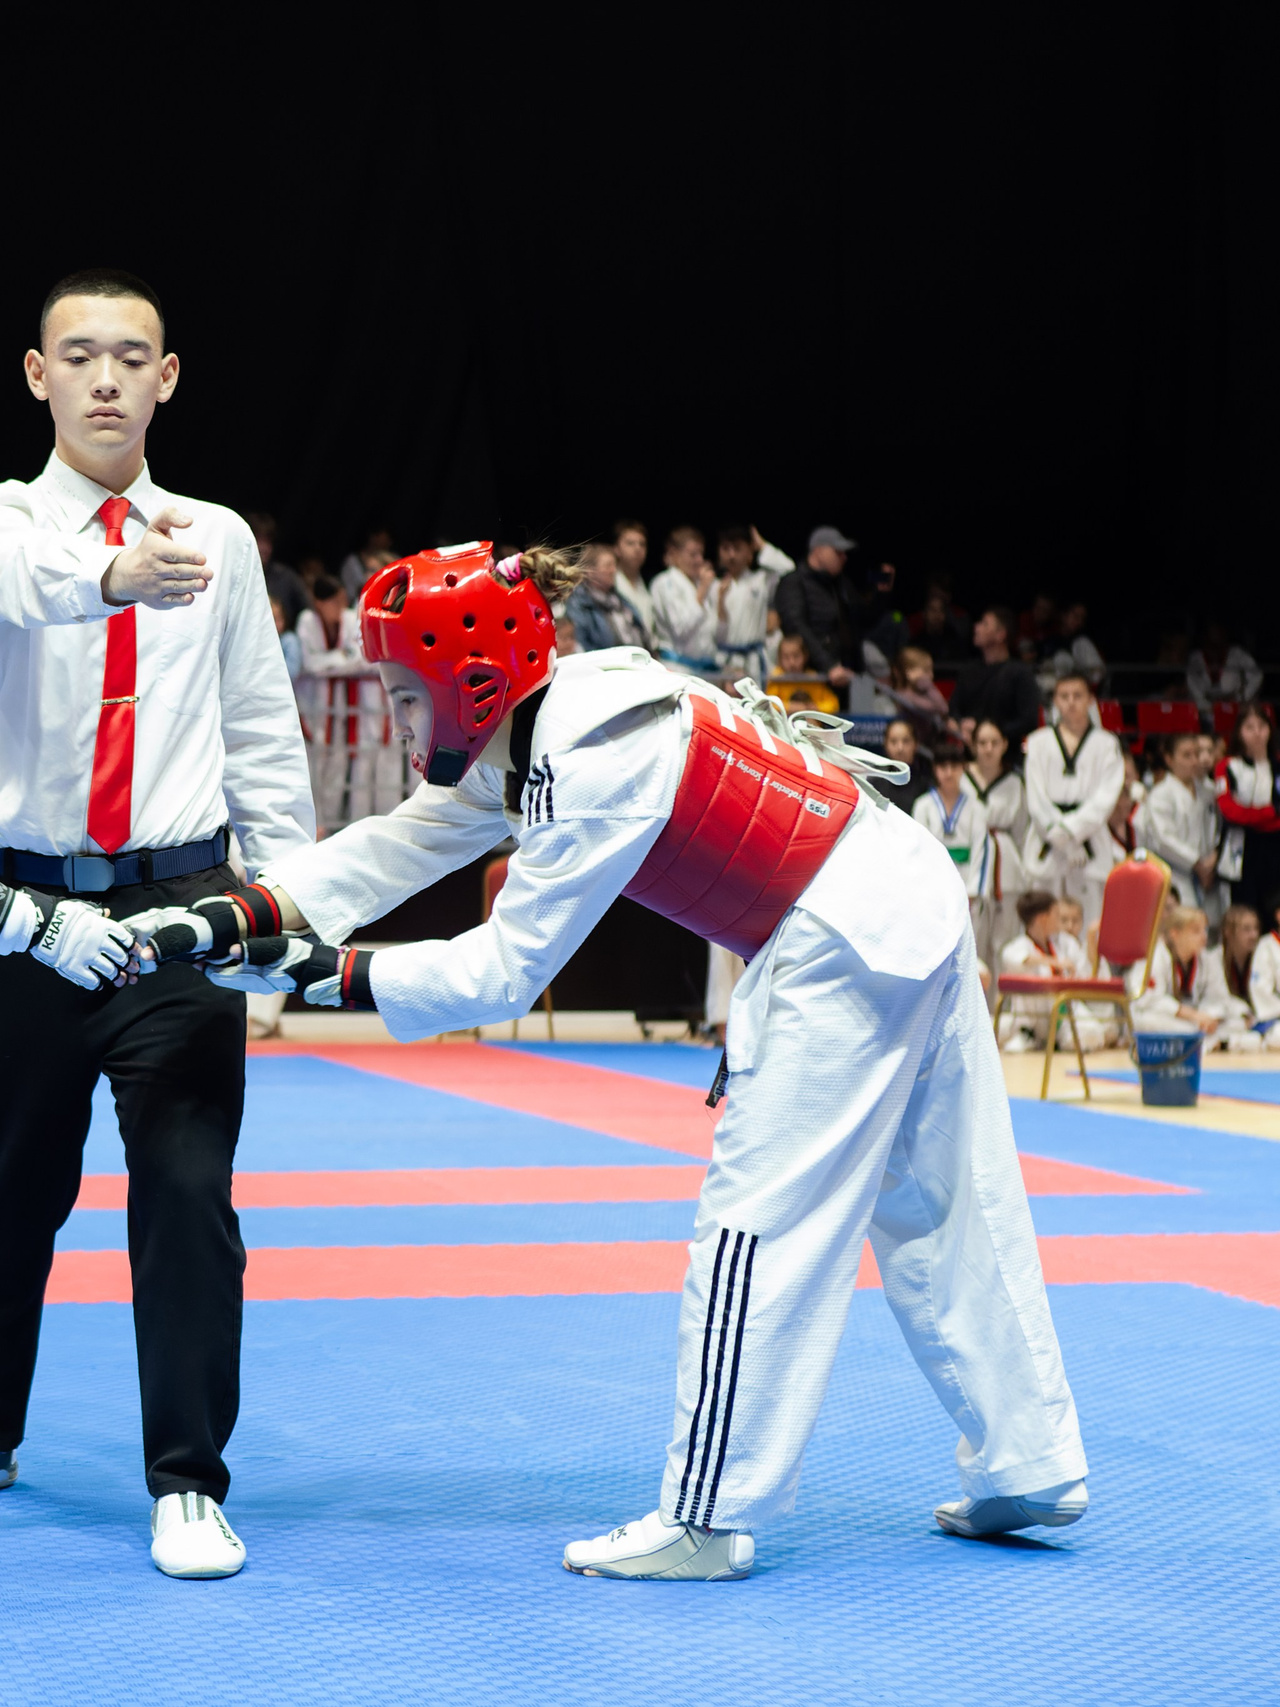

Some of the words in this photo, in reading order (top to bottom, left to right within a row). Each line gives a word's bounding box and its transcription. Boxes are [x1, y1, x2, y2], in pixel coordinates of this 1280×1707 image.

[736, 759, 763, 781] Scoring
[809, 803, 827, 815] PSS
[41, 909, 67, 951] KHAN
